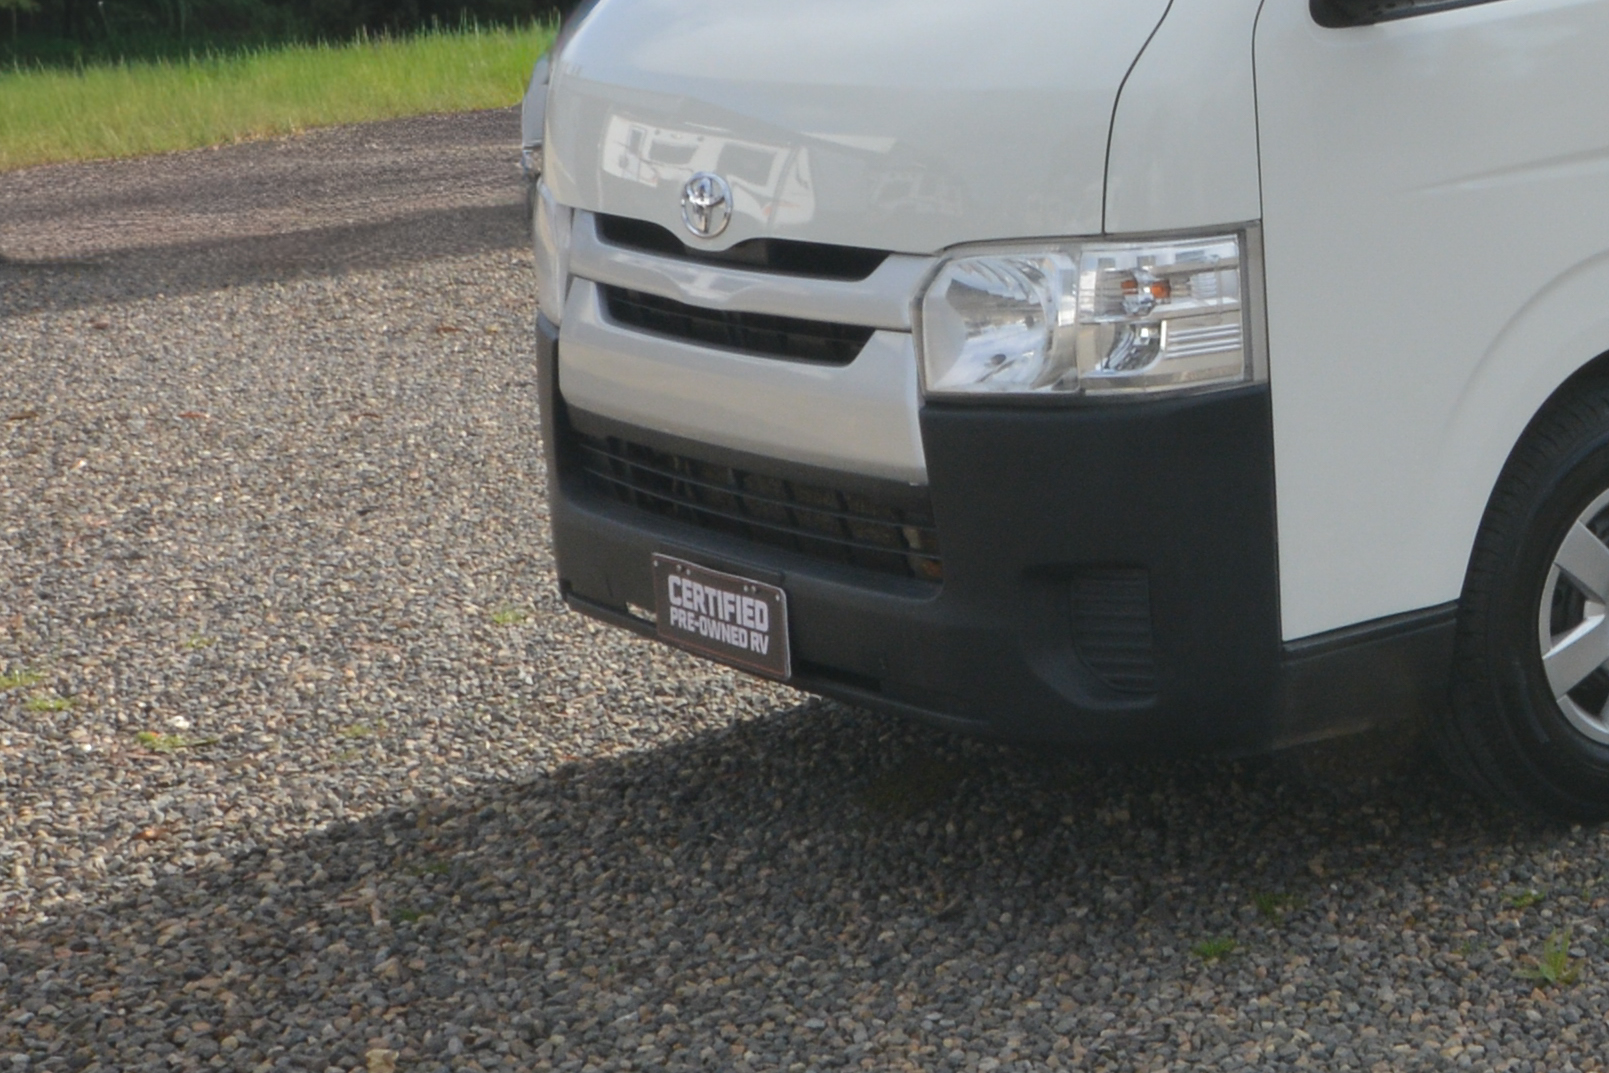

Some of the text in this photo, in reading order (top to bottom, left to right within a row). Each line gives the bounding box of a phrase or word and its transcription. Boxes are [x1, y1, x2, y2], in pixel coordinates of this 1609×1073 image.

[667, 574, 769, 632] CERTIFIED
[669, 606, 769, 655] PRE-OWNED RV
